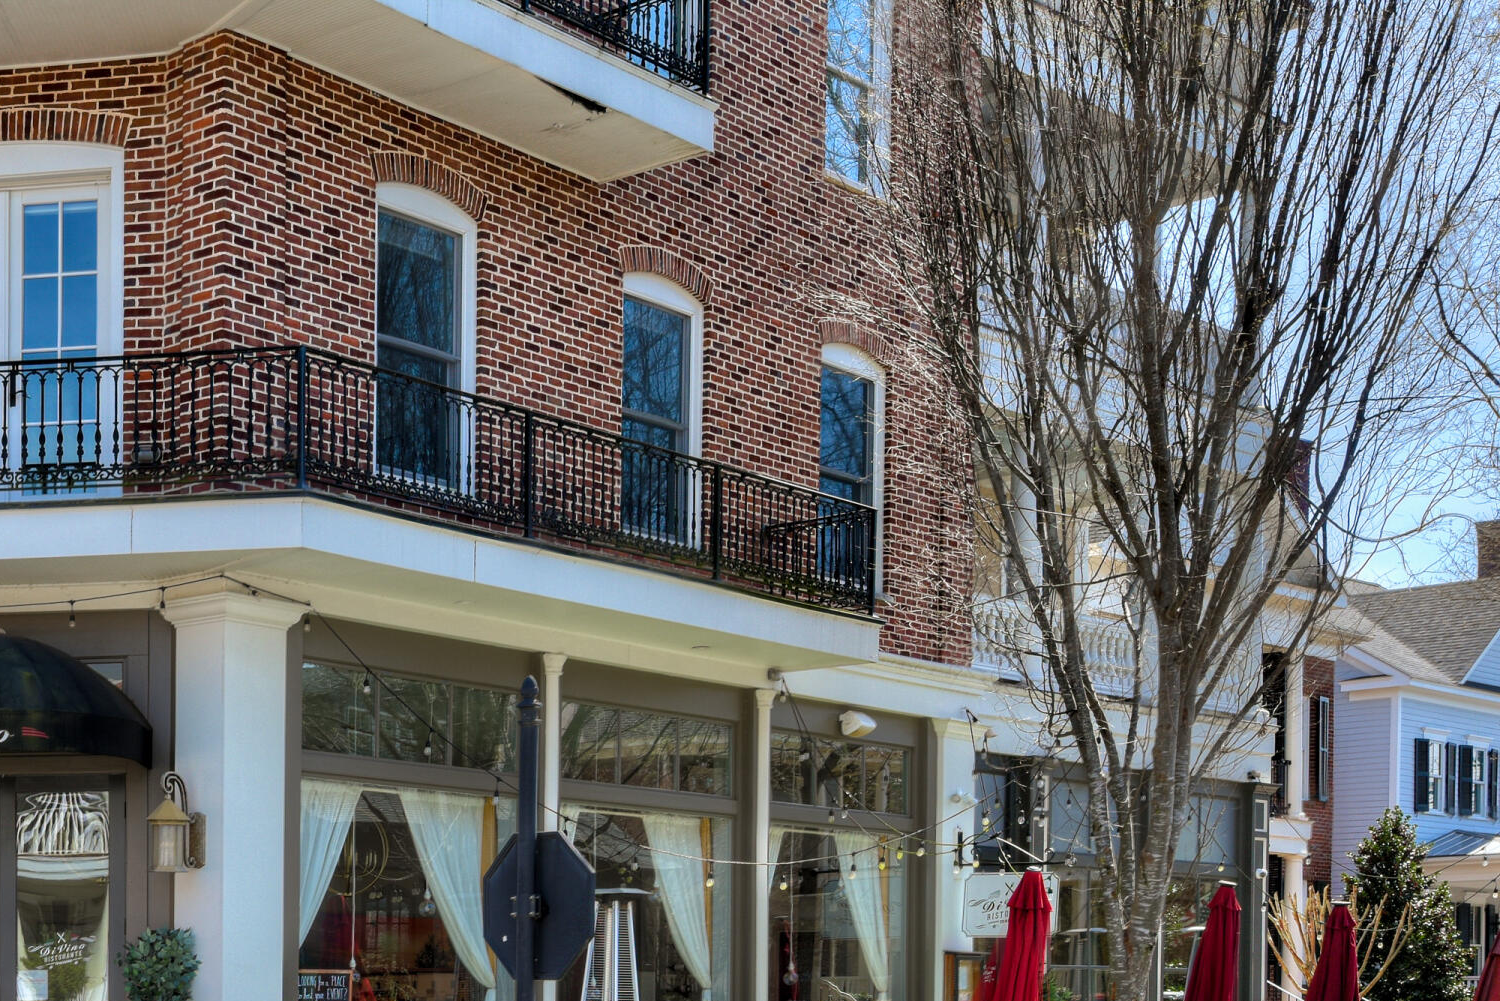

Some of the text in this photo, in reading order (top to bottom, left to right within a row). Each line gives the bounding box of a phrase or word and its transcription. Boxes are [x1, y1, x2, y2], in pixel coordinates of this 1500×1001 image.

[40, 943, 86, 957] DiVino
[43, 949, 83, 964] RISTORANTE
[331, 975, 347, 988] PLACE
[327, 987, 348, 1001] EVENT?
